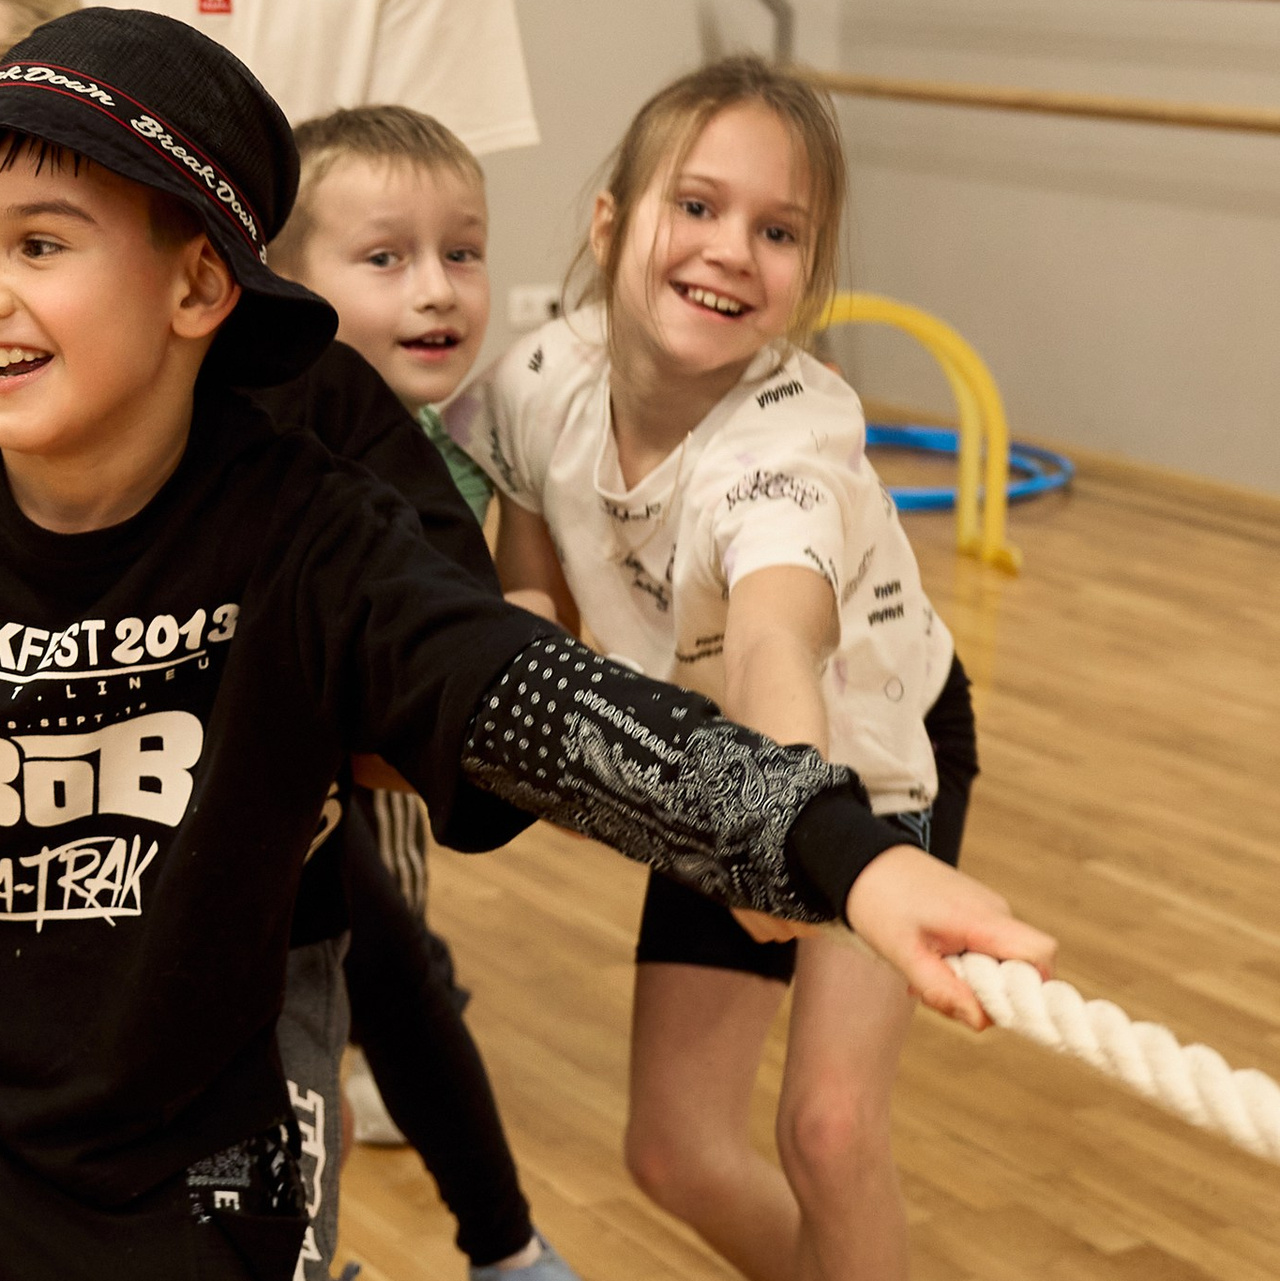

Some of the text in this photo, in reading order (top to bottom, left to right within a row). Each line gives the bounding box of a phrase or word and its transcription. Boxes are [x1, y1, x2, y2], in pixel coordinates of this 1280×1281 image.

[22, 67, 116, 107] Down
[130, 115, 257, 242] Break Down
[111, 603, 240, 664] 2013
[65, 657, 210, 699] LINEU
